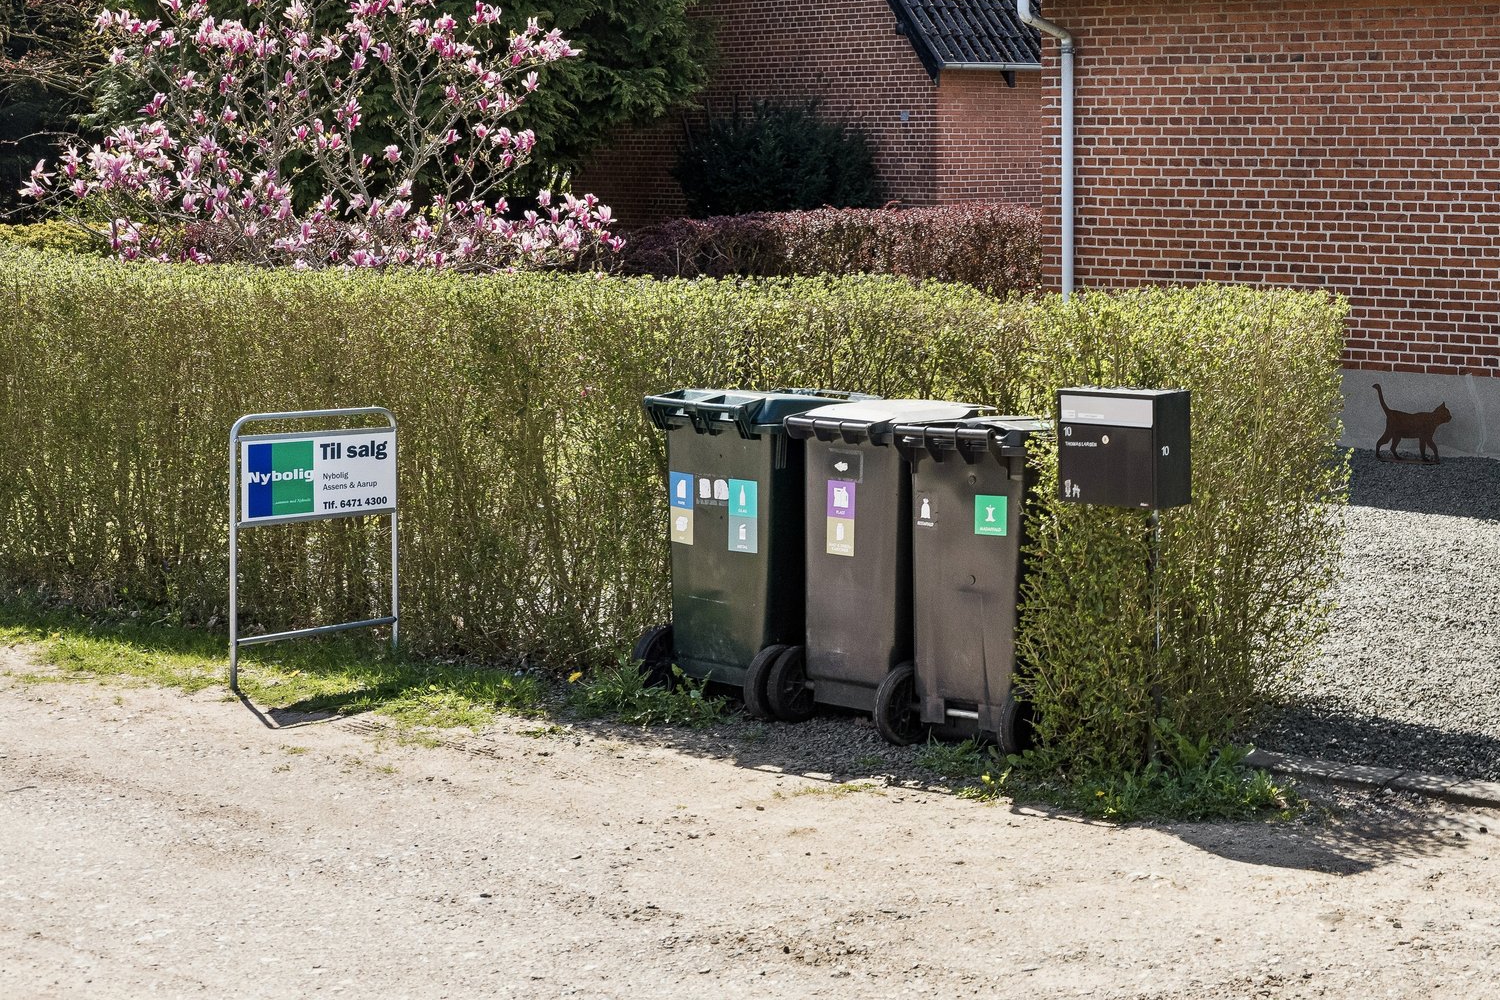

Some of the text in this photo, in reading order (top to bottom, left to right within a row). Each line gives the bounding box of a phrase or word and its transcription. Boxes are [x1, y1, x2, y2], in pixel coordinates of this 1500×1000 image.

[1063, 426, 1072, 437] 10
[320, 440, 388, 460] Til salg
[1161, 446, 1170, 456] 10
[248, 468, 315, 486] Nybolig
[322, 471, 349, 480] Nybolig
[322, 480, 378, 491] Assens & Aarup
[323, 496, 388, 510] Tlf. 6471 4300
